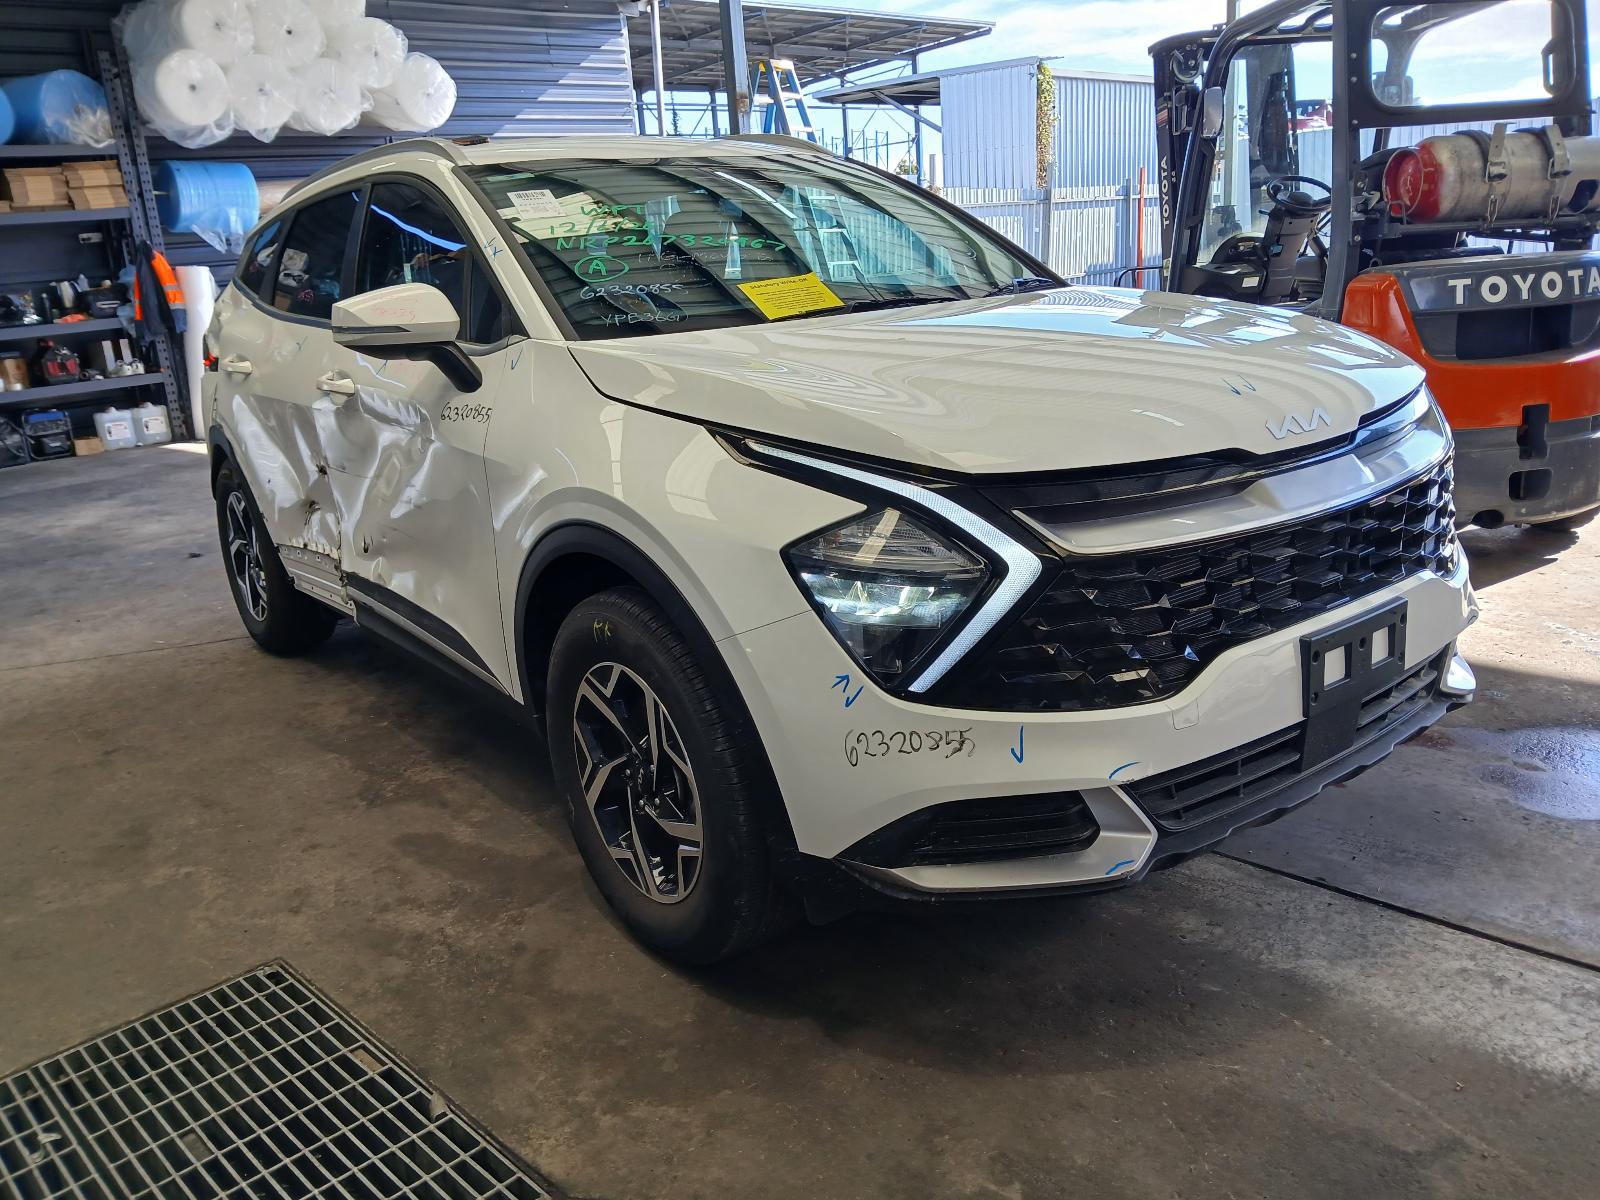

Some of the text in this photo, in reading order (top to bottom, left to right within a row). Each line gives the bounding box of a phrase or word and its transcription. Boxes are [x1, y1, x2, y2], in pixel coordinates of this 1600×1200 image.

[1161, 156, 1170, 229] TOYOTA
[579, 283, 689, 300] 62320855
[1448, 266, 1600, 305] TOYOTA
[440, 402, 493, 424] 62320855
[844, 726, 976, 767] 62320855
